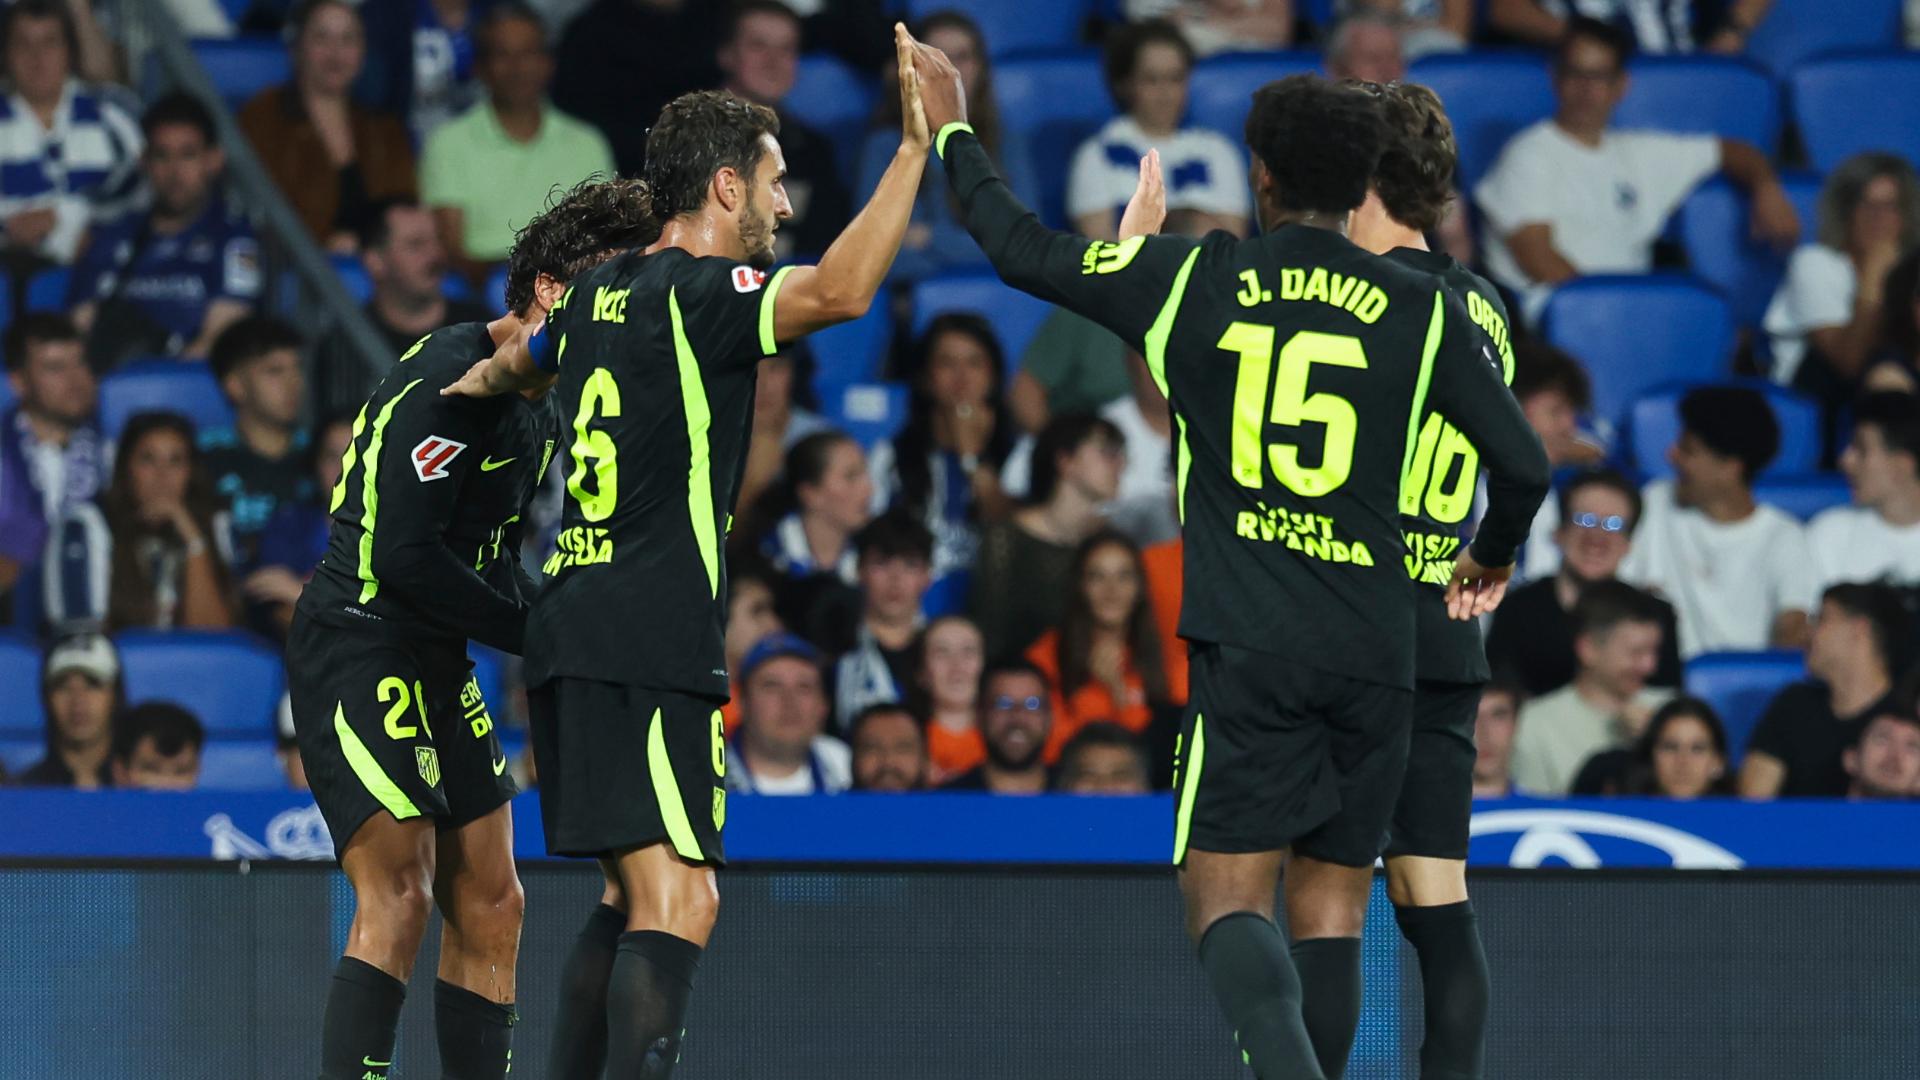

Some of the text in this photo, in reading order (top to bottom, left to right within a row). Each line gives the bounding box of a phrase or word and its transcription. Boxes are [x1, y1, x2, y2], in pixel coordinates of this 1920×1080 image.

[1236, 266, 1389, 325] J. DAVID
[567, 367, 621, 523] 6
[1216, 321, 1369, 497] 15
[1400, 411, 1479, 524] 10
